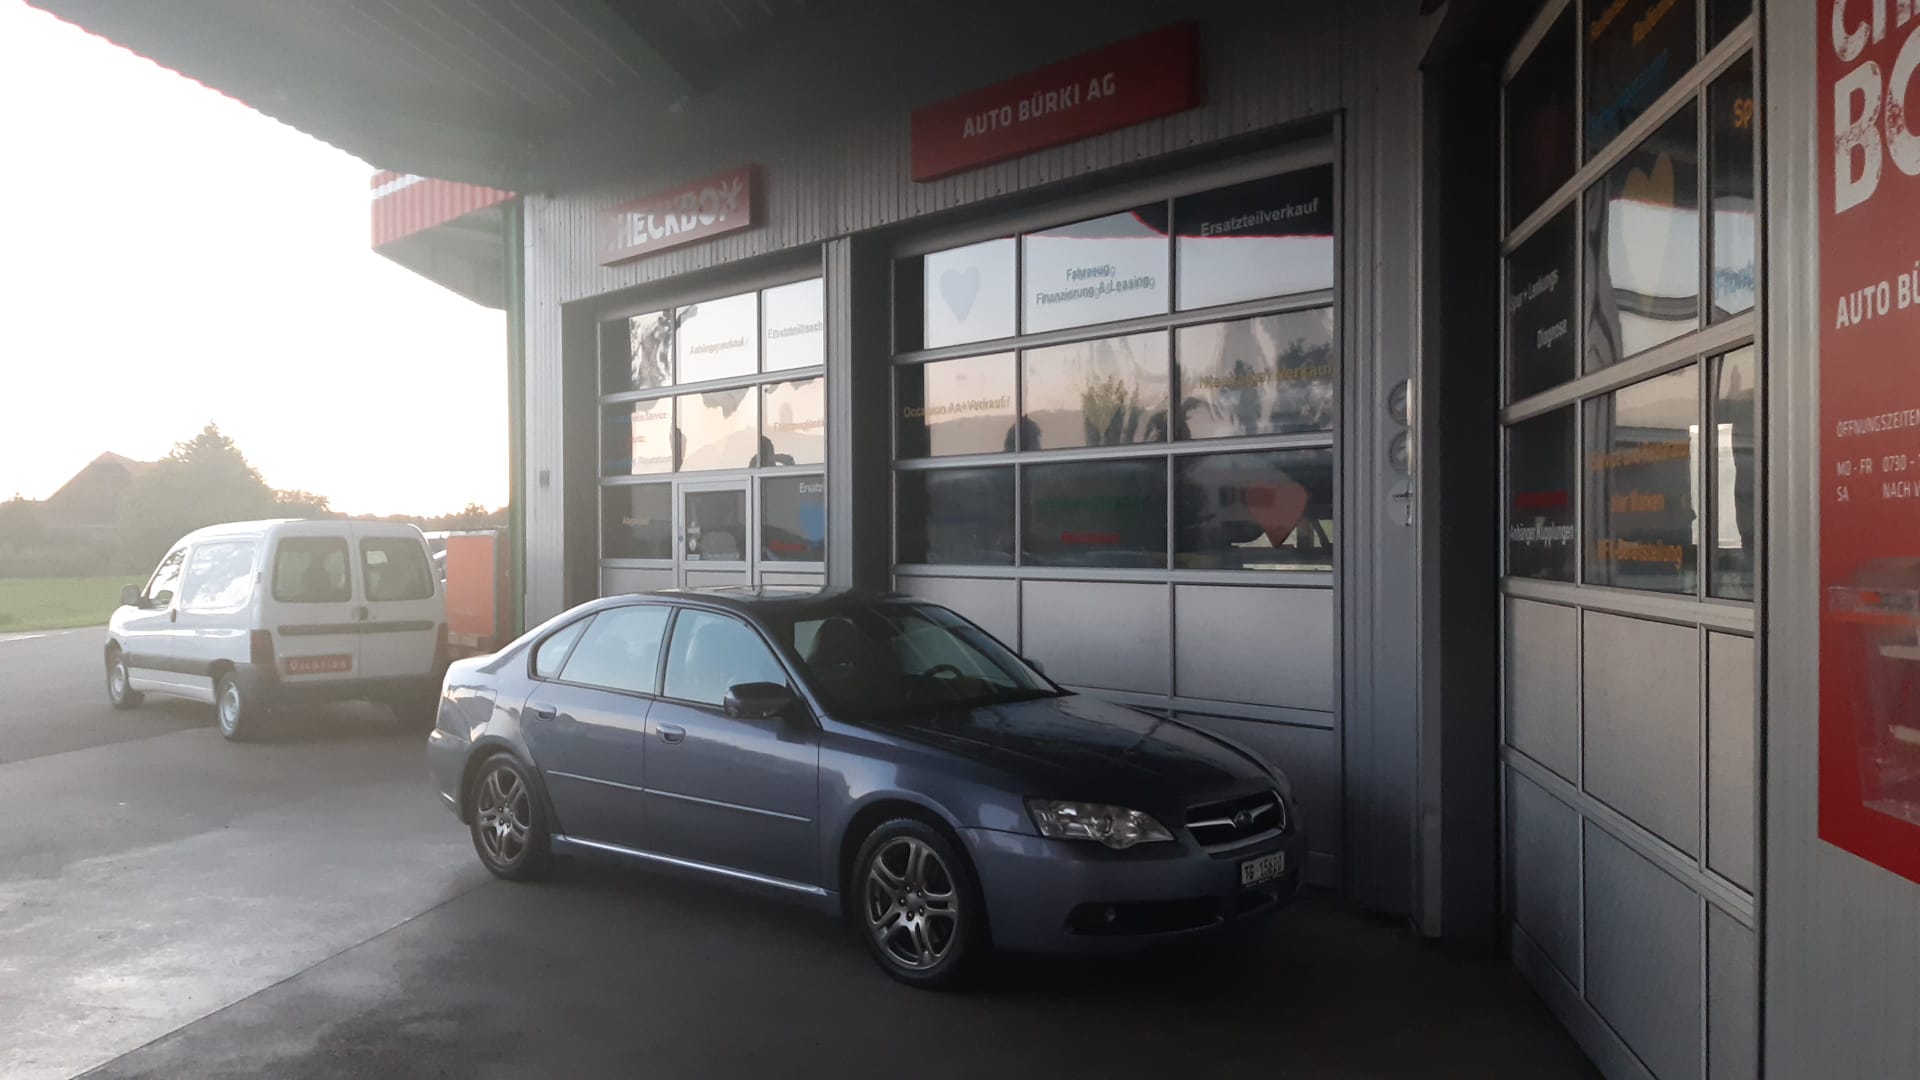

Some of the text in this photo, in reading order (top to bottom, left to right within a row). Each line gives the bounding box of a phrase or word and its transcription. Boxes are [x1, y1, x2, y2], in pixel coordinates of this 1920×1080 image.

[963, 71, 1116, 139] AUTO BÜRKI AG
[1200, 196, 1320, 237] Ersatzteilverkauf
[1066, 264, 1112, 282] Fahrzeug
[1036, 286, 1095, 306] Finanzierung
[1110, 275, 1152, 293] Leasing
[1836, 281, 1890, 329] AUTO
[1837, 460, 1851, 477] MO
[1859, 458, 1872, 474] FR
[1882, 454, 1907, 472] 0730
[1837, 485, 1849, 502] SA
[1882, 480, 1911, 498] NACH
[1536, 521, 1574, 548] Kupplungen
